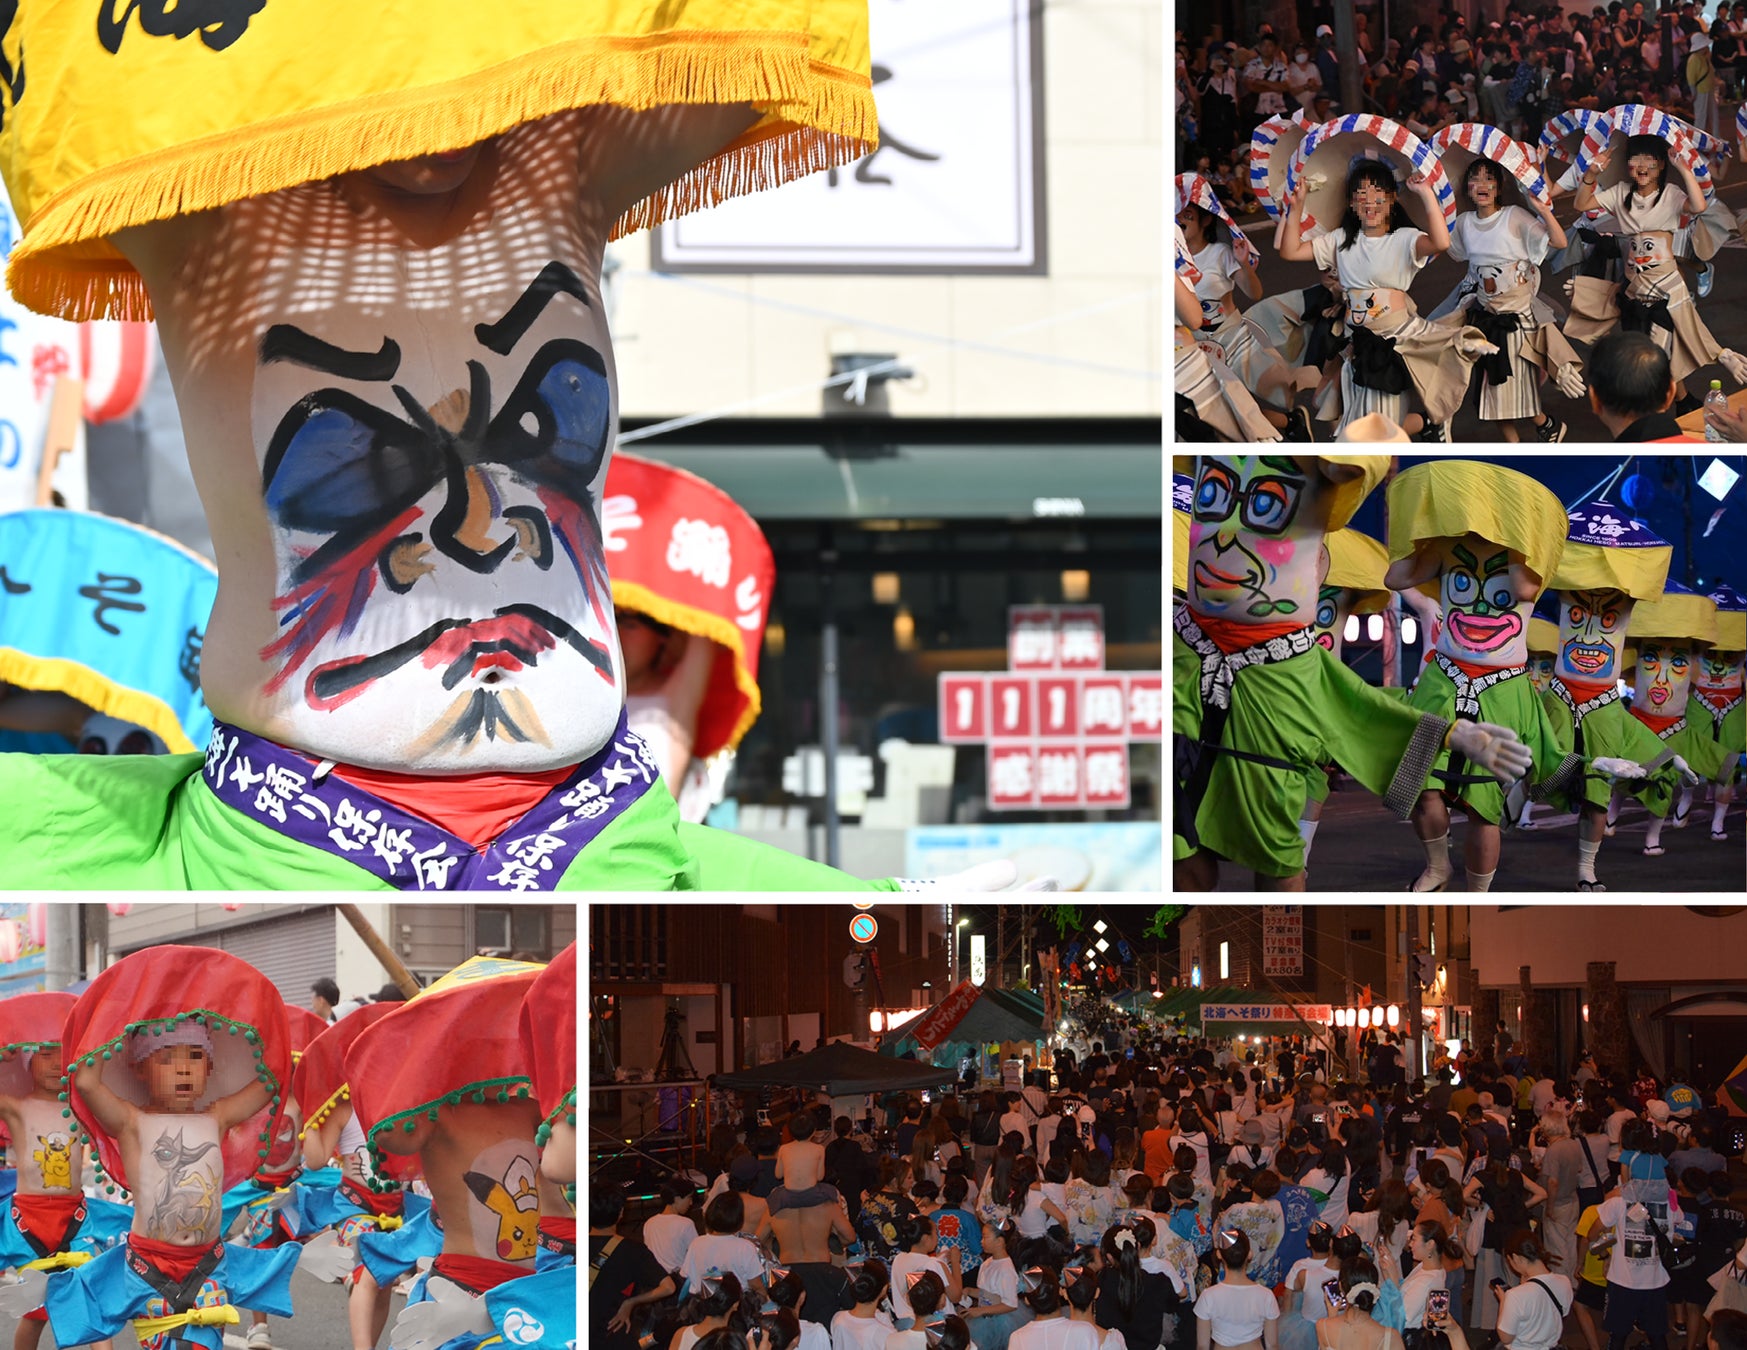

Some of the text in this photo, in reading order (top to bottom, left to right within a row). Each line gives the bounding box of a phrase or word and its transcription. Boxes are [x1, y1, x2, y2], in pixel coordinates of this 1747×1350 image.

[955, 686, 1162, 731] 111周年
[990, 753, 1125, 798] 感謝祭
[1204, 1006, 1271, 1019] 北海へそ祭り
